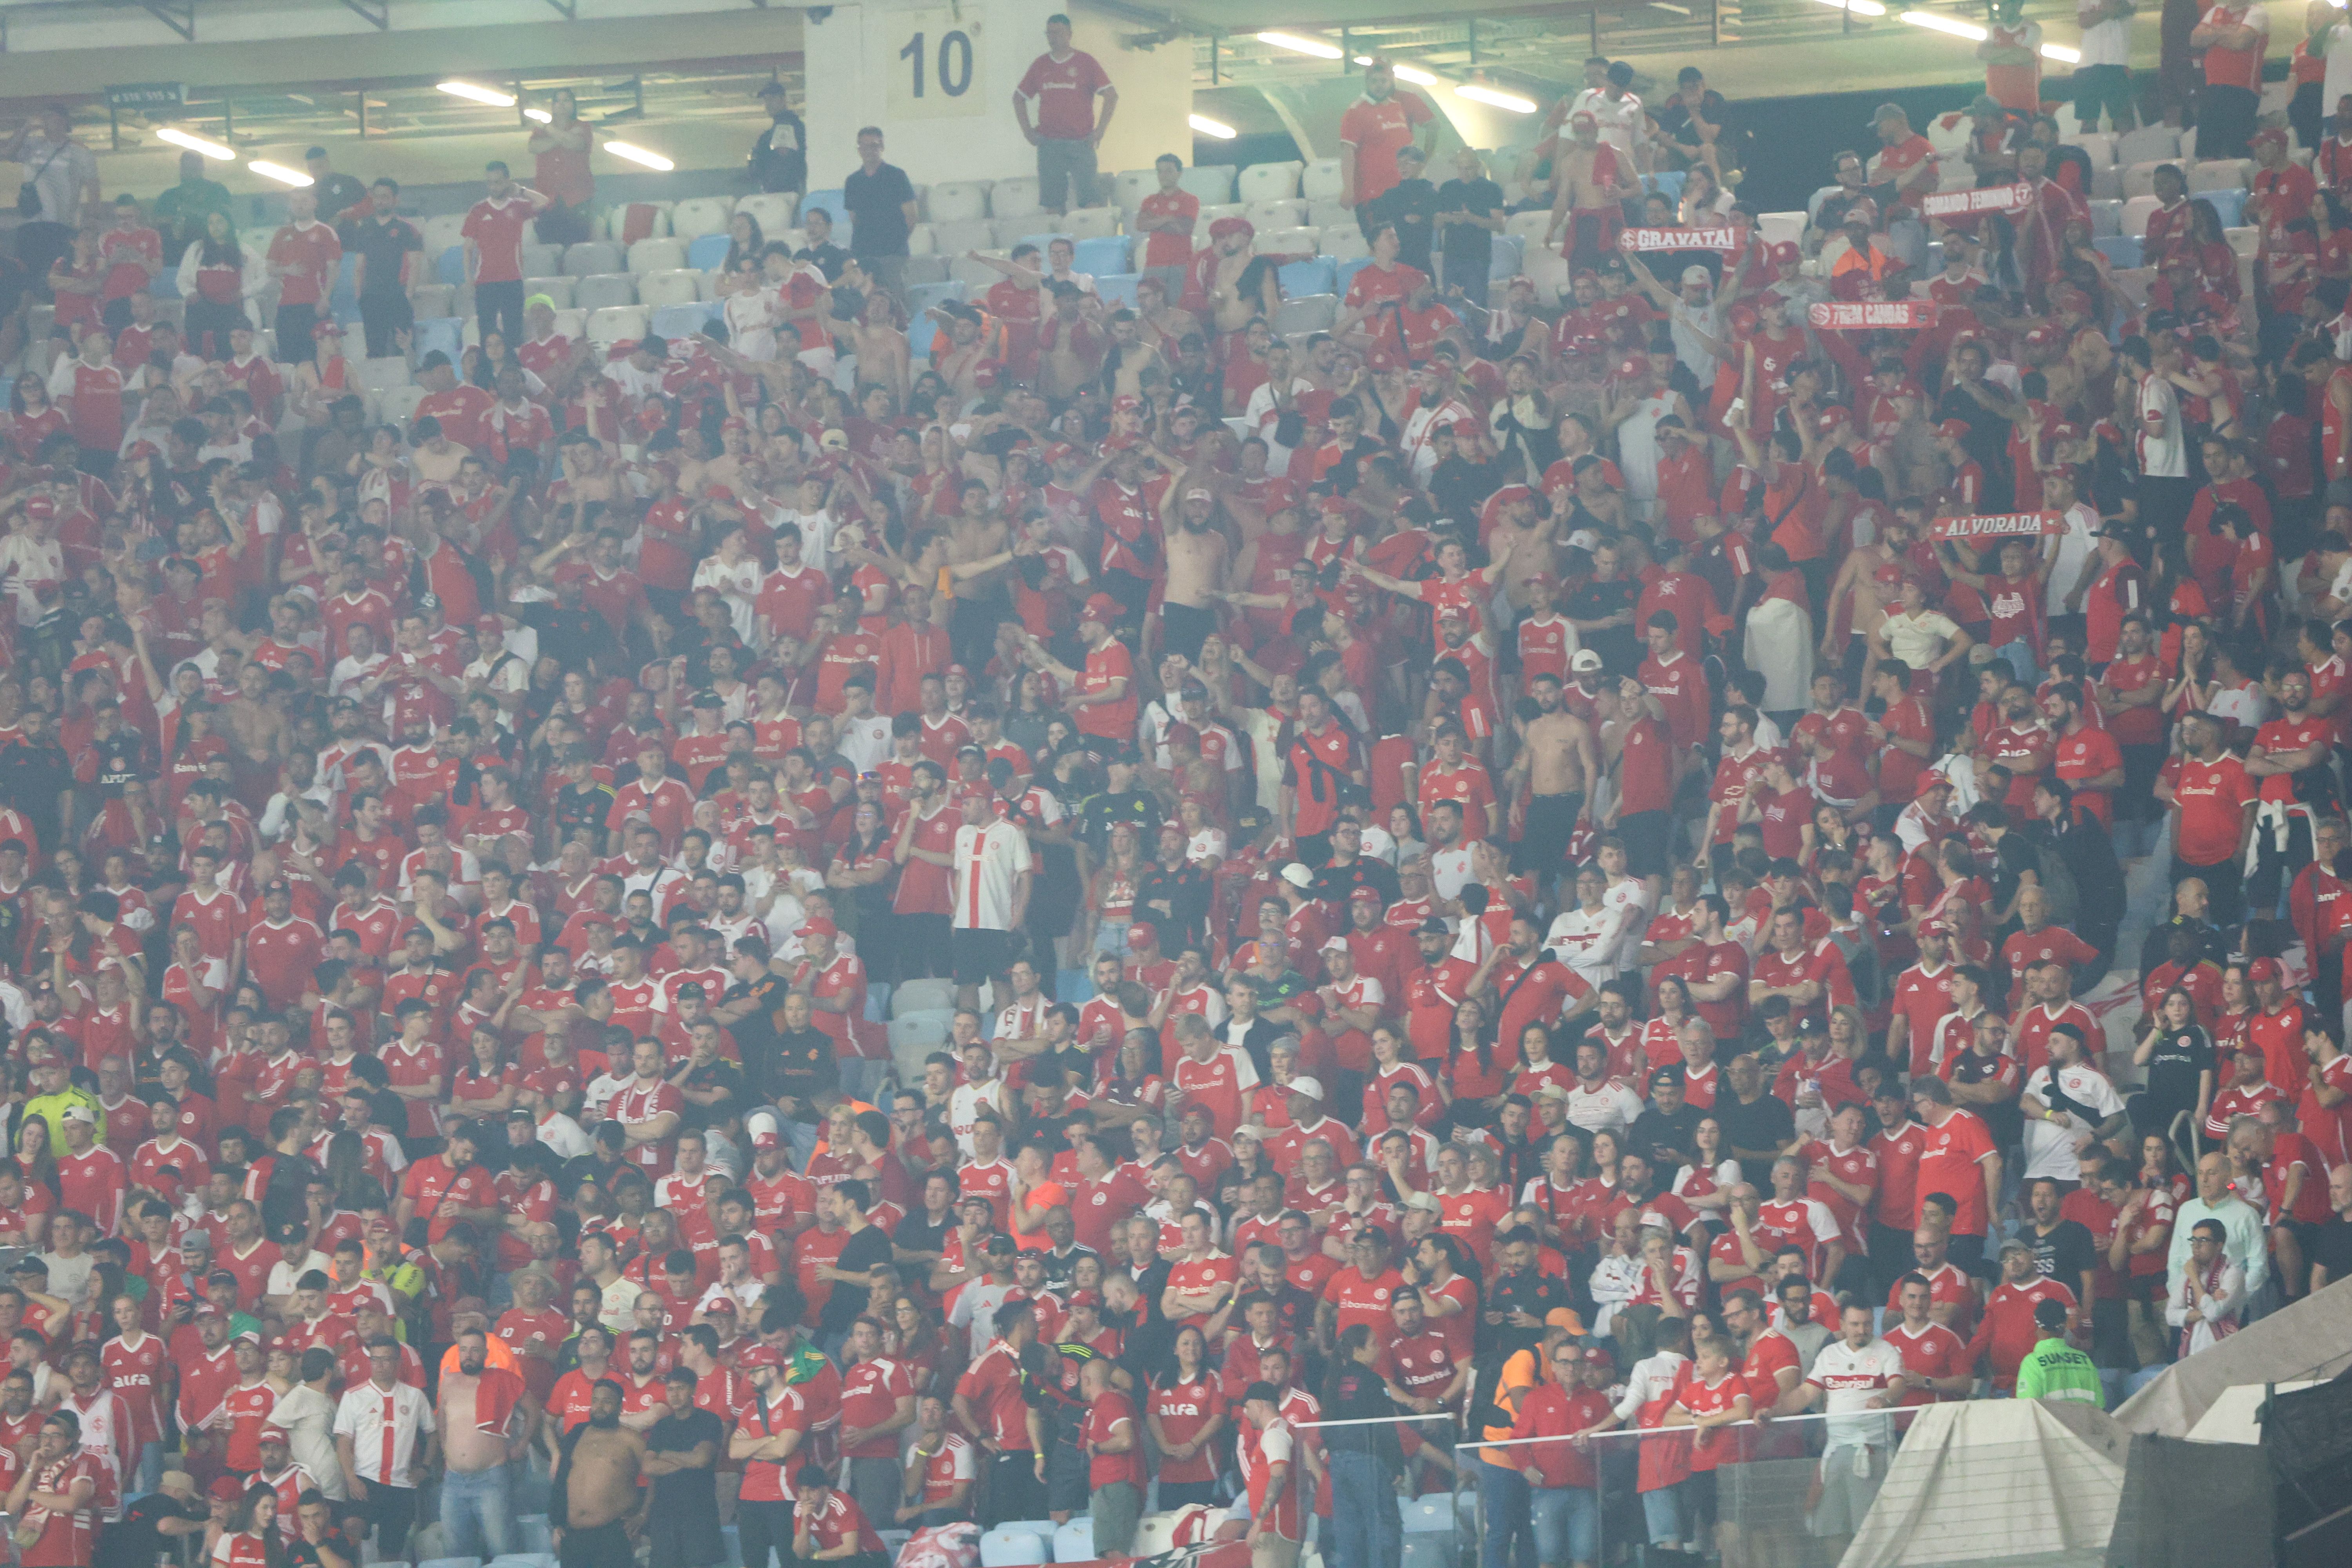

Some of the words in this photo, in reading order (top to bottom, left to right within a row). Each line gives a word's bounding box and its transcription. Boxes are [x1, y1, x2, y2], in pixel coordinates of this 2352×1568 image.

[900, 29, 973, 99] 10
[1945, 515, 2042, 536] ALVORADA
[113, 1374, 151, 1388] alfa
[1825, 1377, 1874, 1389] Banrisul
[1160, 1404, 1198, 1416] alfa
